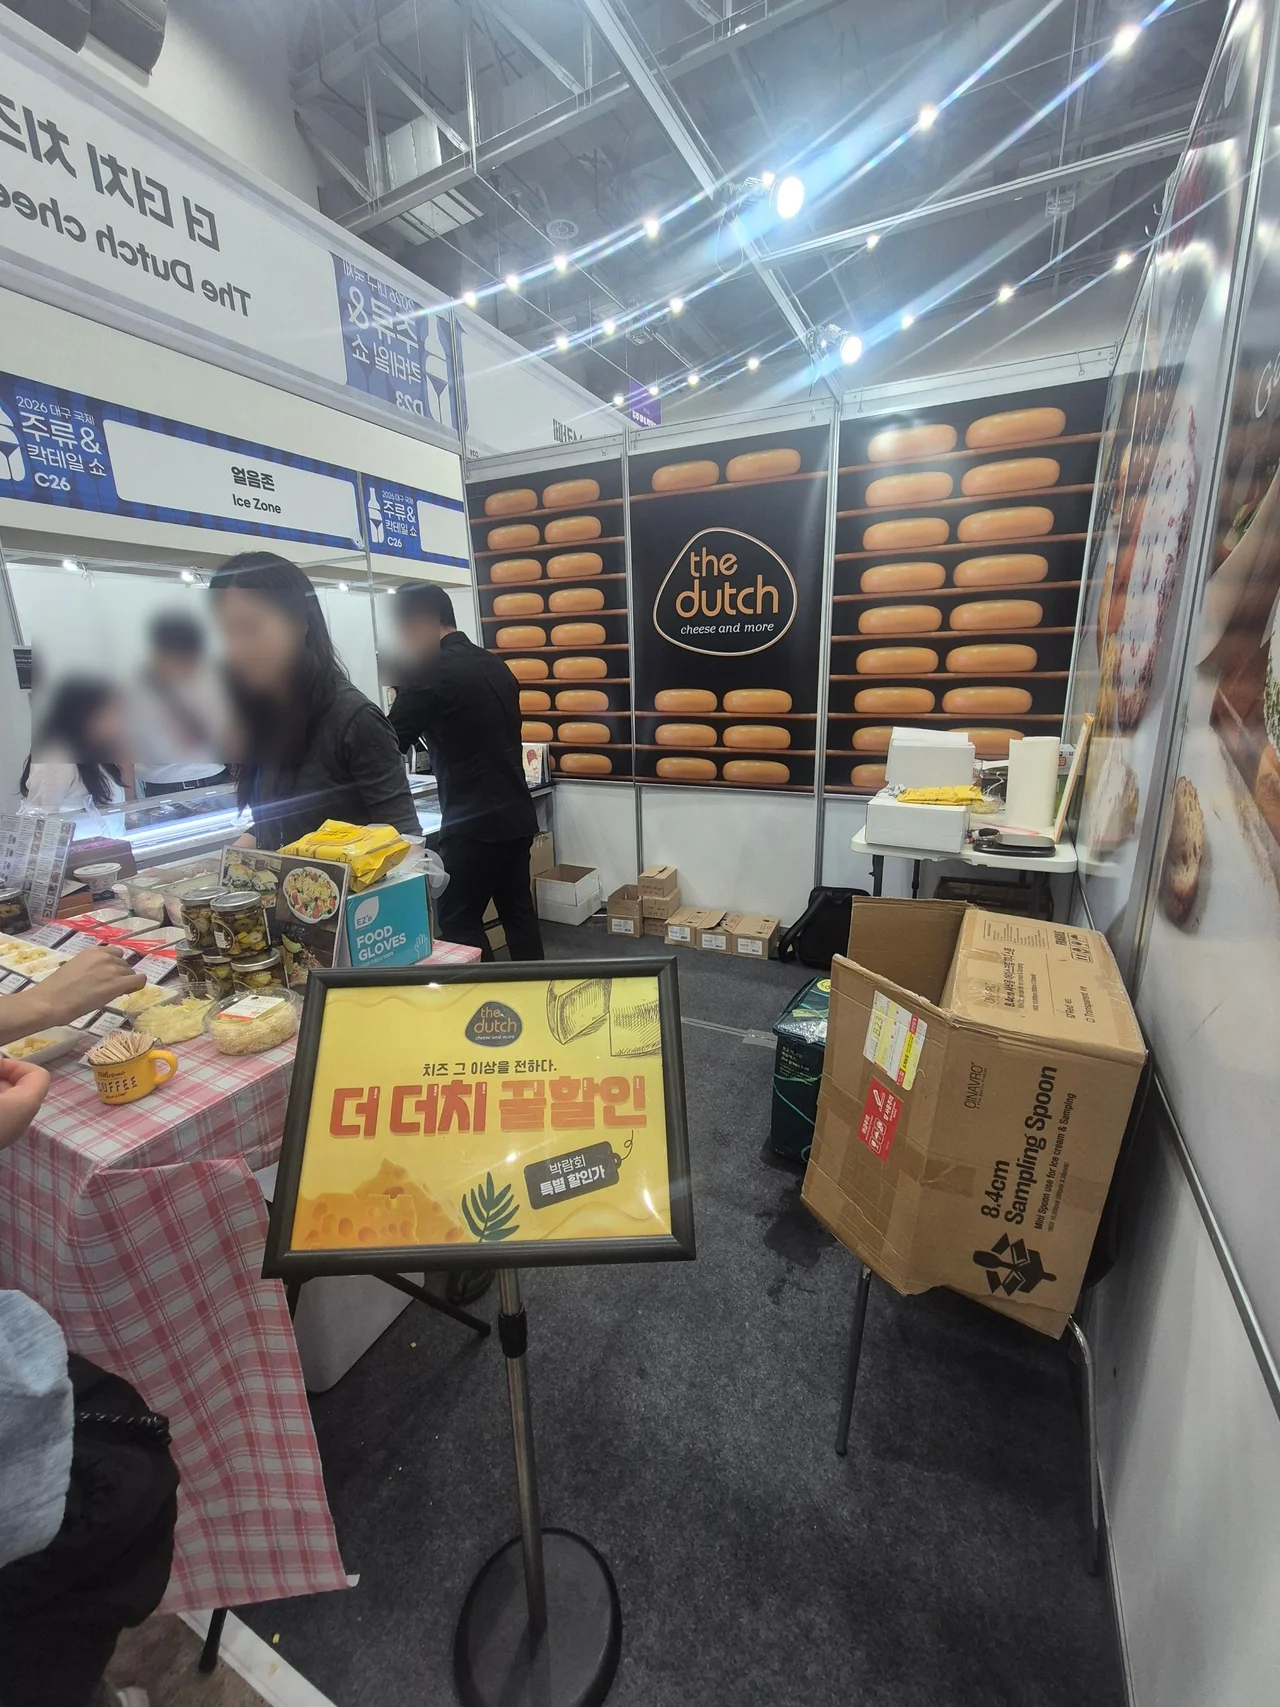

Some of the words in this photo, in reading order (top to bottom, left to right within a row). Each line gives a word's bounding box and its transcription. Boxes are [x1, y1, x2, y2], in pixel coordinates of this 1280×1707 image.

[15, 395, 48, 414] 2026
[49, 404, 71, 419] 대구
[74, 409, 95, 426] 국제
[26, 443, 85, 473] 칵테일
[88, 458, 107, 476] 쇼
[34, 472, 71, 491] C26
[231, 466, 275, 492] 얼음존
[232, 493, 251, 508] Ice
[252, 497, 281, 514] Zone
[382, 490, 395, 500] 2026
[385, 519, 409, 536] 칵테일
[410, 526, 418, 537] 쇼
[387, 536, 403, 548] C26
[690, 547, 738, 577] the
[675, 574, 779, 618] dutch
[680, 624, 716, 635] cheese
[718, 623, 741, 633] and
[744, 623, 775, 632] more
[356, 925, 393, 948] FOOD
[358, 932, 407, 961] GLOVES
[480, 1007, 501, 1018] the
[474, 1017, 517, 1033] dutch
[423, 1063, 448, 1076] 치즈
[453, 1063, 466, 1075] 그
[471, 1060, 510, 1075] 이상을
[514, 1059, 557, 1073] 전하다.
[329, 1086, 381, 1140] 더
[389, 1079, 488, 1137] 더치
[499, 1075, 647, 1133] 꿀할인
[1024, 1066, 1058, 1132] Spoon
[1054, 1134, 1065, 1157] cream
[549, 1154, 586, 1175] 박람회
[1051, 1157, 1060, 1169] Ice
[540, 1177, 566, 1196] 특별
[567, 1164, 606, 1189] 할인가
[981, 1160, 1010, 1219] 8.4cm
[1004, 1133, 1047, 1225] Sampling
[1045, 1180, 1054, 1193] use
[1038, 1193, 1050, 1214] Spoon
[1034, 1211, 1045, 1230] Mini
